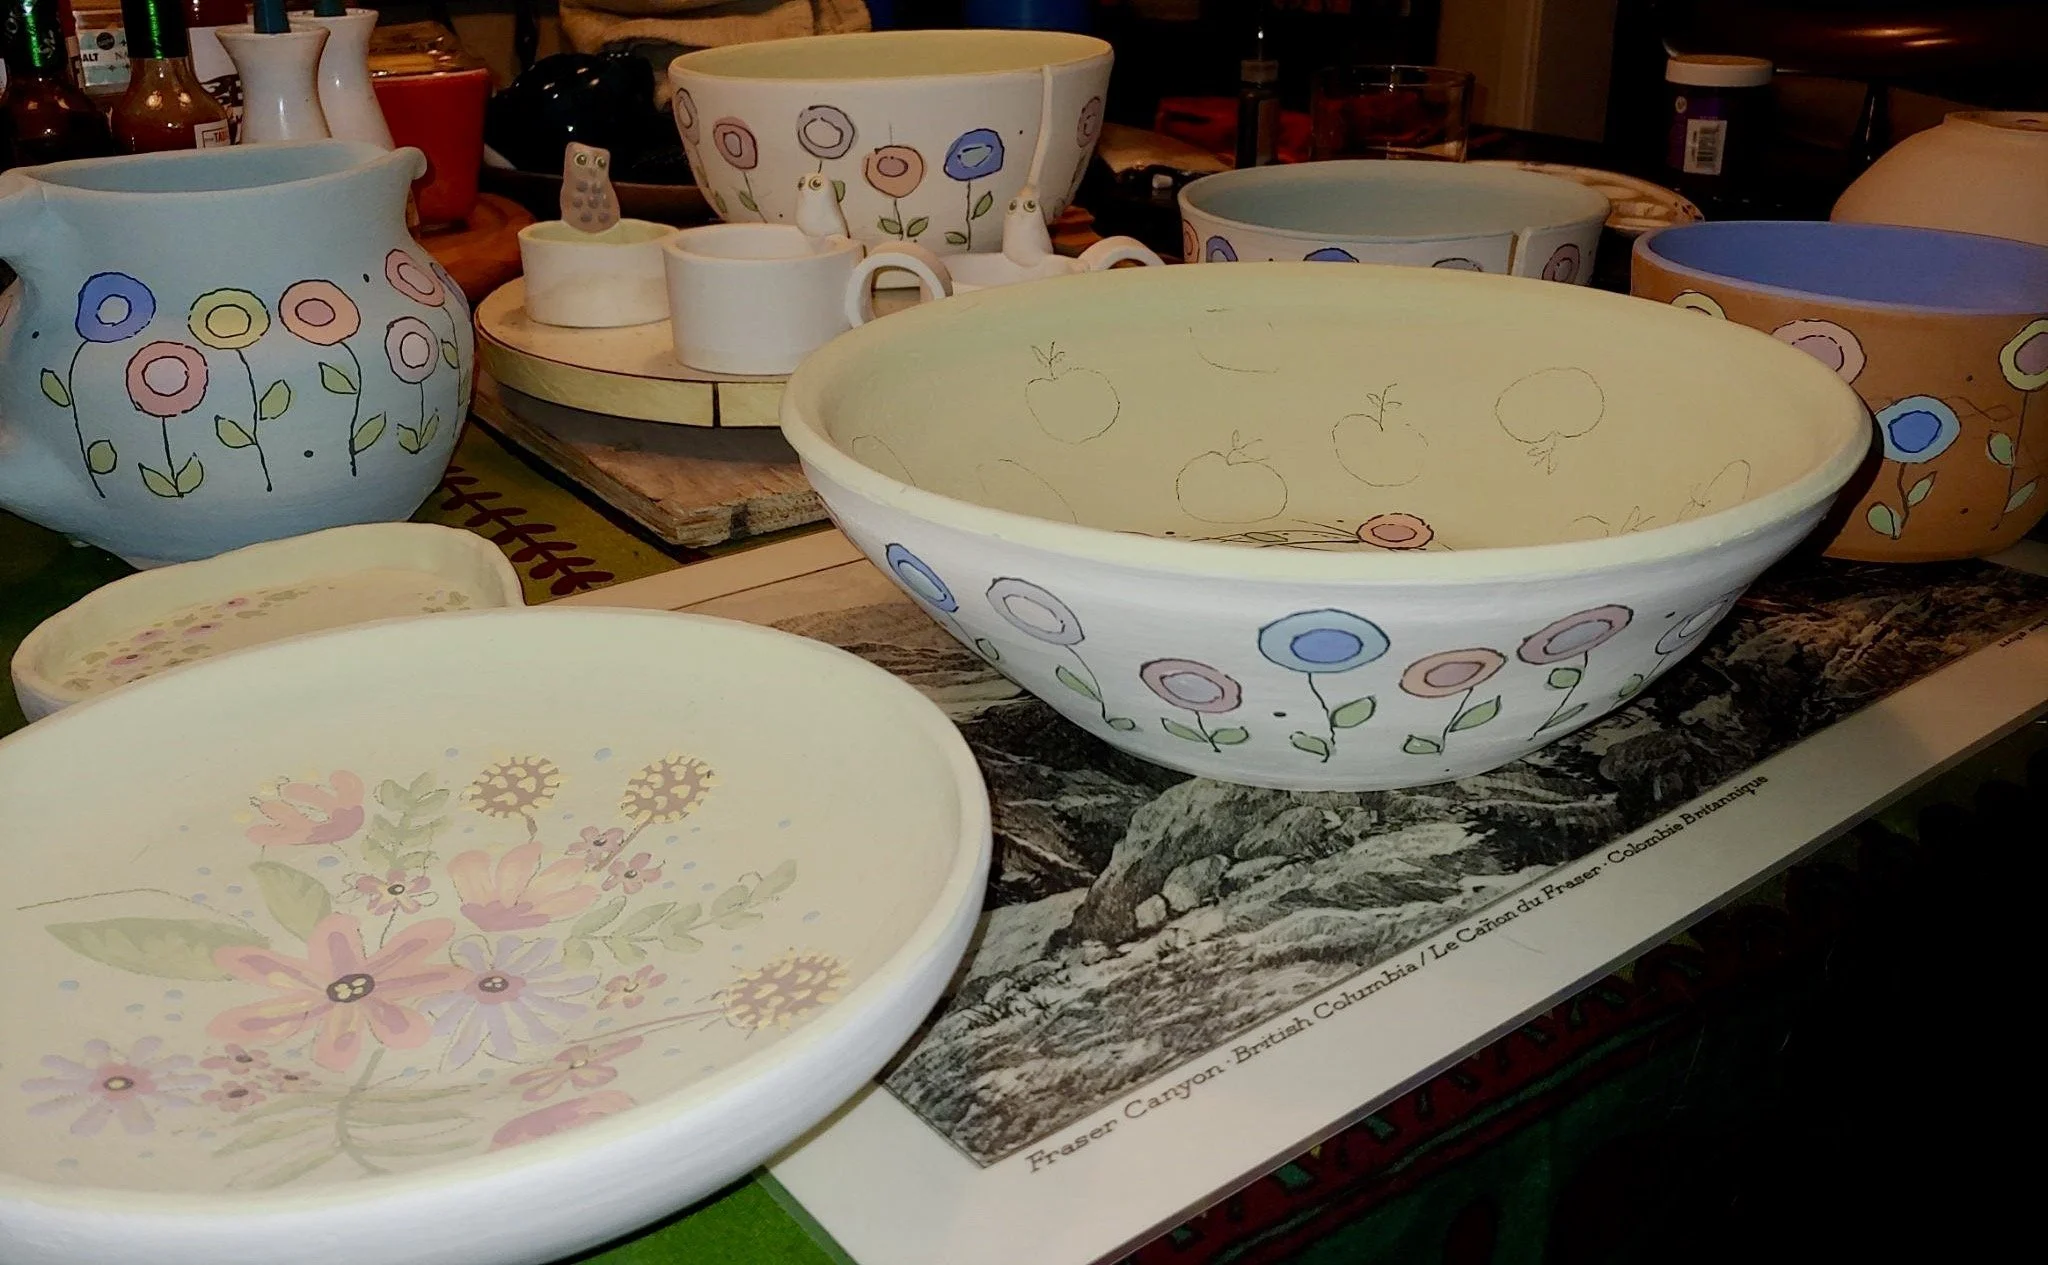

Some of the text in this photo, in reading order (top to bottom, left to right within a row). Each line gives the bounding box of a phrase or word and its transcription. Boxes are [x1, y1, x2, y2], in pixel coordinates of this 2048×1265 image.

[82, 53, 98, 62] ALT
[1025, 1119, 1118, 1173] Fraser
[1124, 1057, 1225, 1119] Canyon
[1231, 1016, 1314, 1064] British
[1313, 963, 1419, 1019] Columbia
[1428, 942, 1459, 959] Le
[1456, 910, 1520, 943] Cañon
[1516, 897, 1543, 913] du
[1541, 866, 1602, 900] Fraser
[1607, 823, 1684, 864] Colombie
[1679, 775, 1769, 826] Britannique
